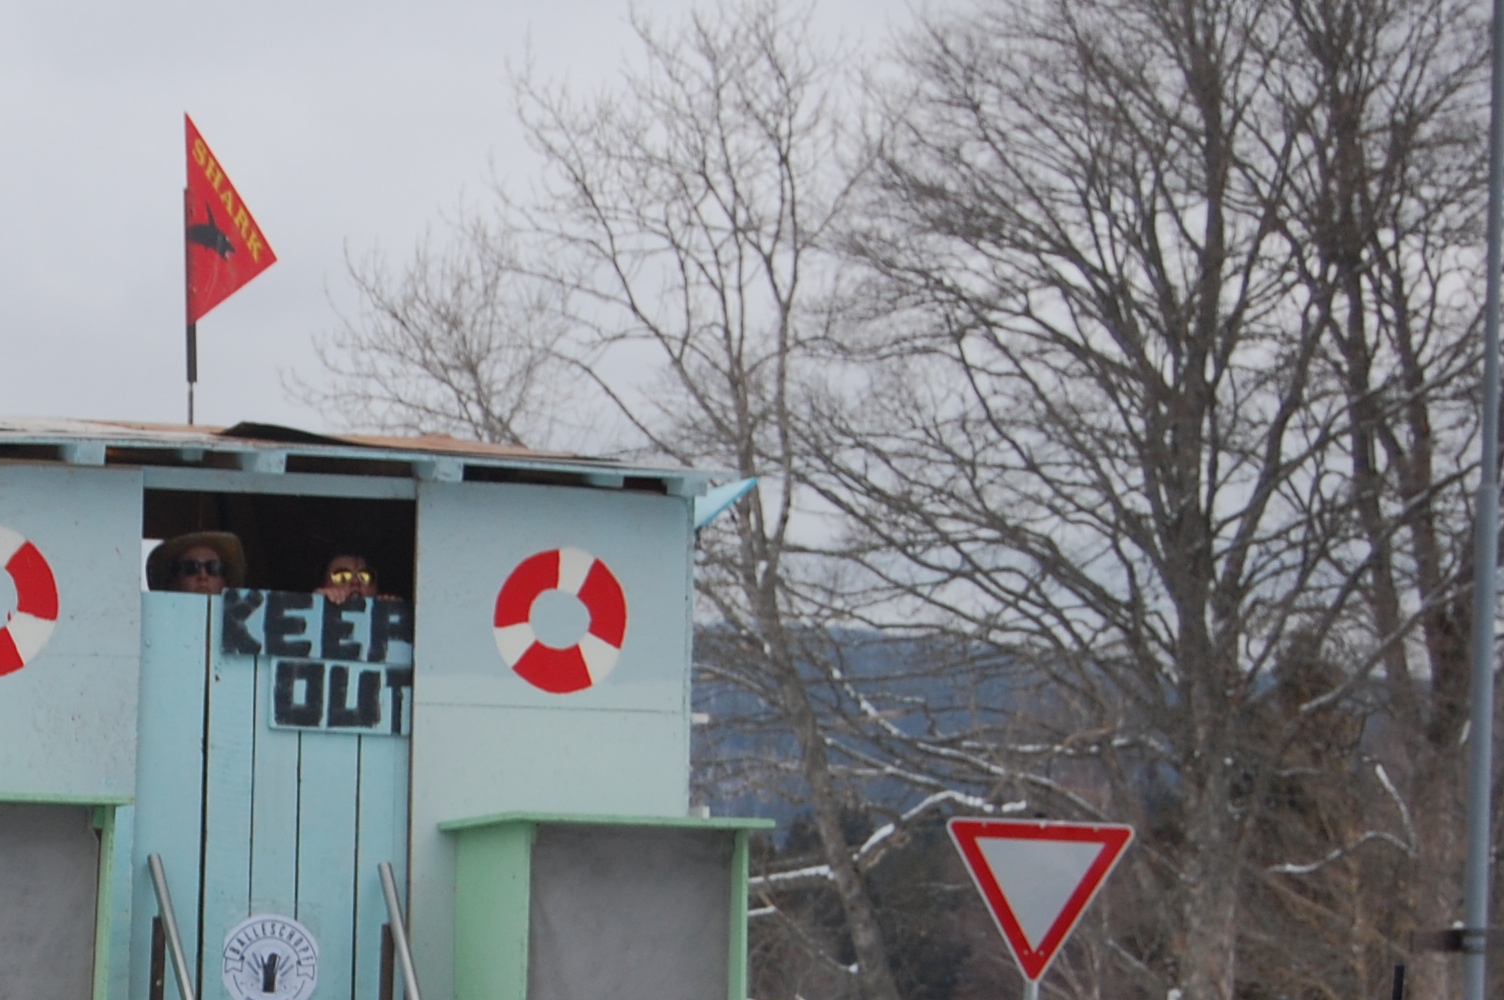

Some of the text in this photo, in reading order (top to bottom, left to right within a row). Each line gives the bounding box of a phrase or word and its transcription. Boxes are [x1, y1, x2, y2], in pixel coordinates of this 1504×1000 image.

[192, 138, 263, 265] SHARK
[222, 588, 413, 663] KEEP
[274, 660, 412, 734] OUT
